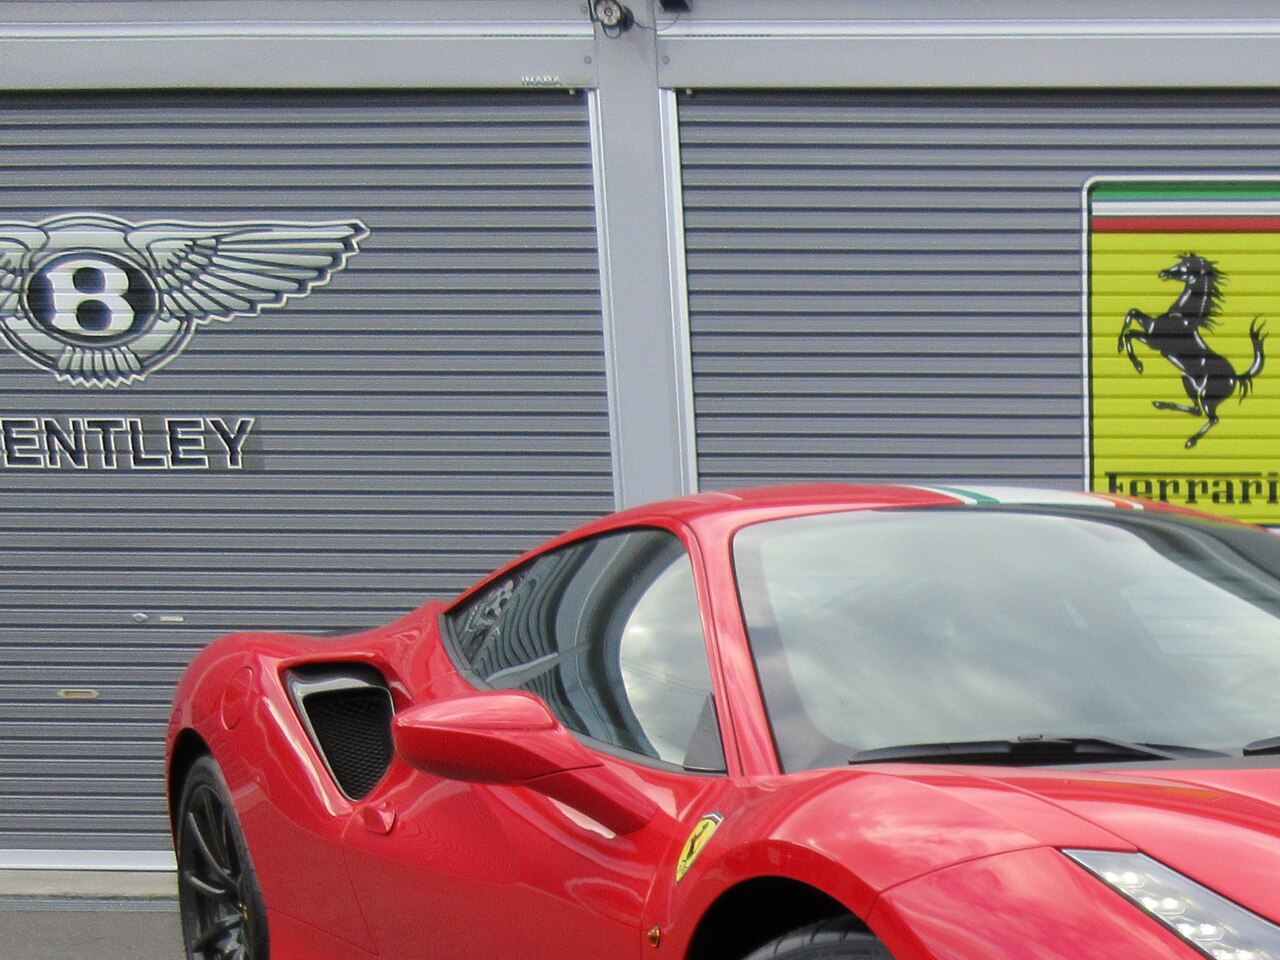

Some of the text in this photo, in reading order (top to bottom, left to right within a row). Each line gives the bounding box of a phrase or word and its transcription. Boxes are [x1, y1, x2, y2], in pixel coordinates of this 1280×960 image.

[46, 259, 136, 338] B
[0, 418, 255, 469] ENTLEY
[1105, 472, 1280, 504] Ferrari
